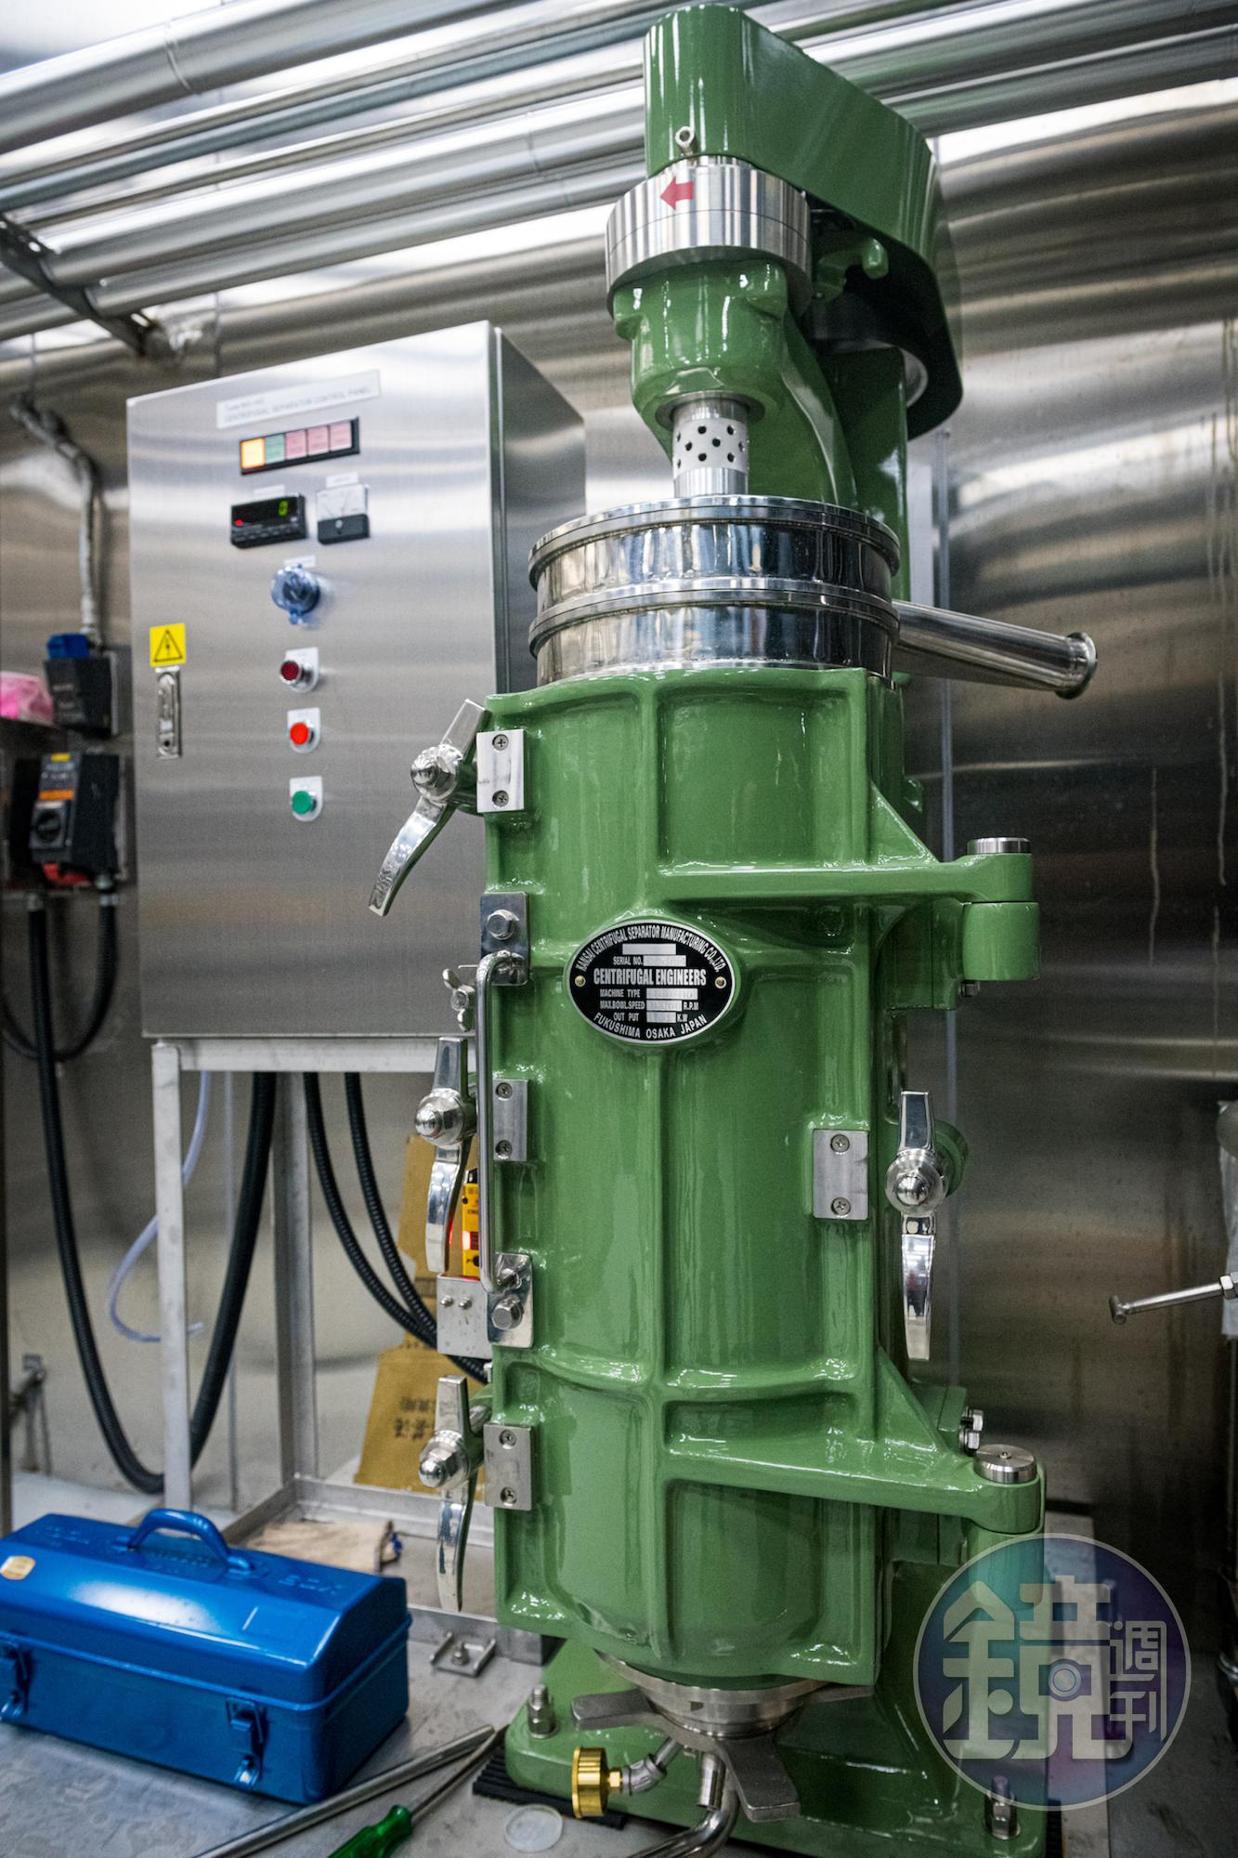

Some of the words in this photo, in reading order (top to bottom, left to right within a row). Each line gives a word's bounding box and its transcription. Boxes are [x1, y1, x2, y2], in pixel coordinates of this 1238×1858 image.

[575, 947, 596, 972] KANSAI
[590, 928, 628, 954] CENTRIFUGAL
[627, 925, 660, 940] SEPARATOR
[660, 925, 709, 954] MANUFACTURING
[613, 956, 631, 965] SERIAL
[593, 968, 654, 985] CENTRIFUGAL
[655, 968, 707, 986] ENGINEERS
[600, 988, 624, 998] MACHINE
[627, 989, 641, 998] TYPE
[613, 1012, 625, 1021] OUT
[628, 1012, 640, 1022] PUT
[593, 1012, 641, 1038] FUKUSHIMA
[645, 1026, 676, 1039] OSAKA
[680, 1013, 708, 1034] JAPAN
